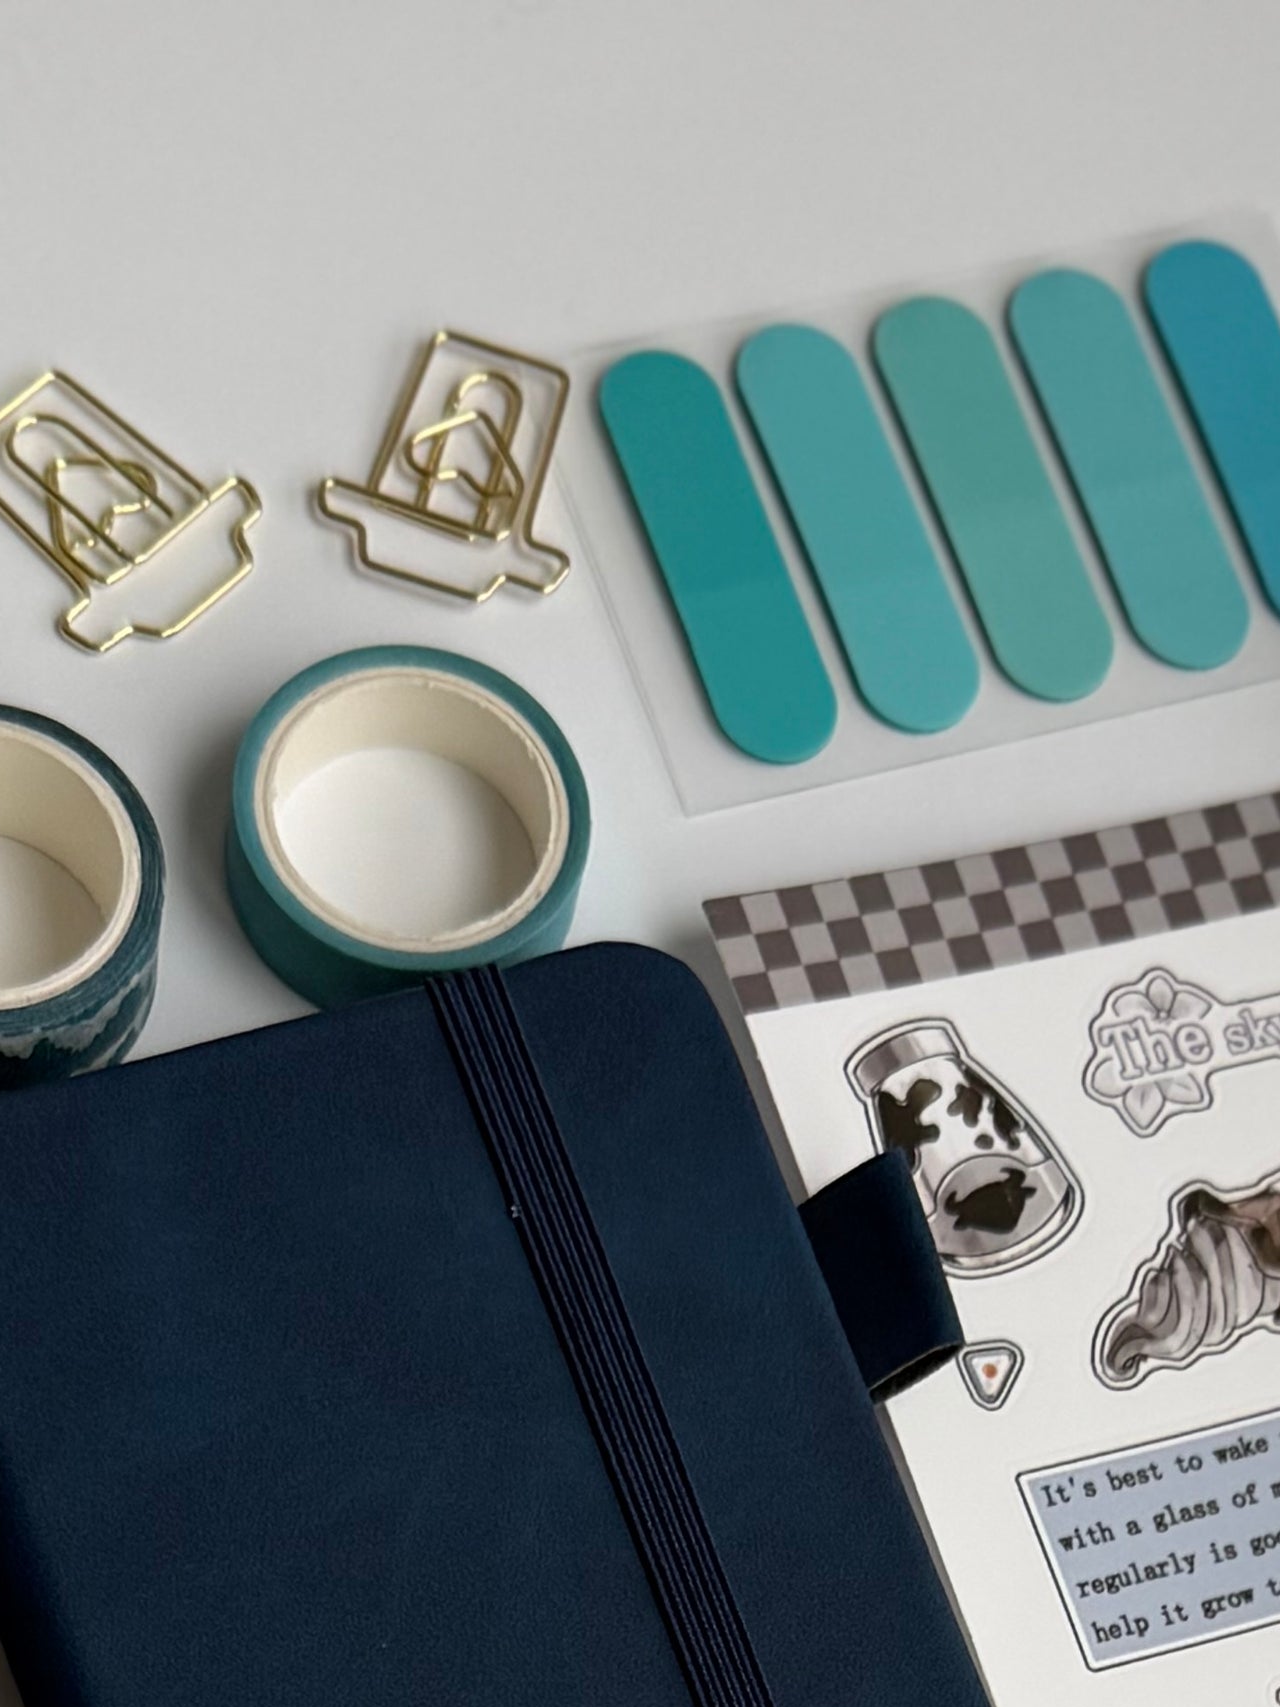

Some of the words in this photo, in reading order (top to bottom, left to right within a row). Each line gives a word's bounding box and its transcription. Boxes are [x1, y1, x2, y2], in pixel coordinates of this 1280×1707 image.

[1100, 1021, 1213, 1082] The
[1041, 1478, 1097, 1507] It's
[1106, 1463, 1163, 1491] best
[1175, 1455, 1203, 1473] to
[1213, 1436, 1268, 1464] wake
[1058, 1522, 1115, 1551] with
[1126, 1520, 1142, 1536] a
[1153, 1500, 1220, 1533] glass
[1232, 1483, 1259, 1508] of
[1076, 1553, 1195, 1598] regularly
[1210, 1542, 1238, 1563] is
[1091, 1614, 1149, 1643] help
[1161, 1605, 1188, 1626] it
[1201, 1588, 1253, 1619] grow
